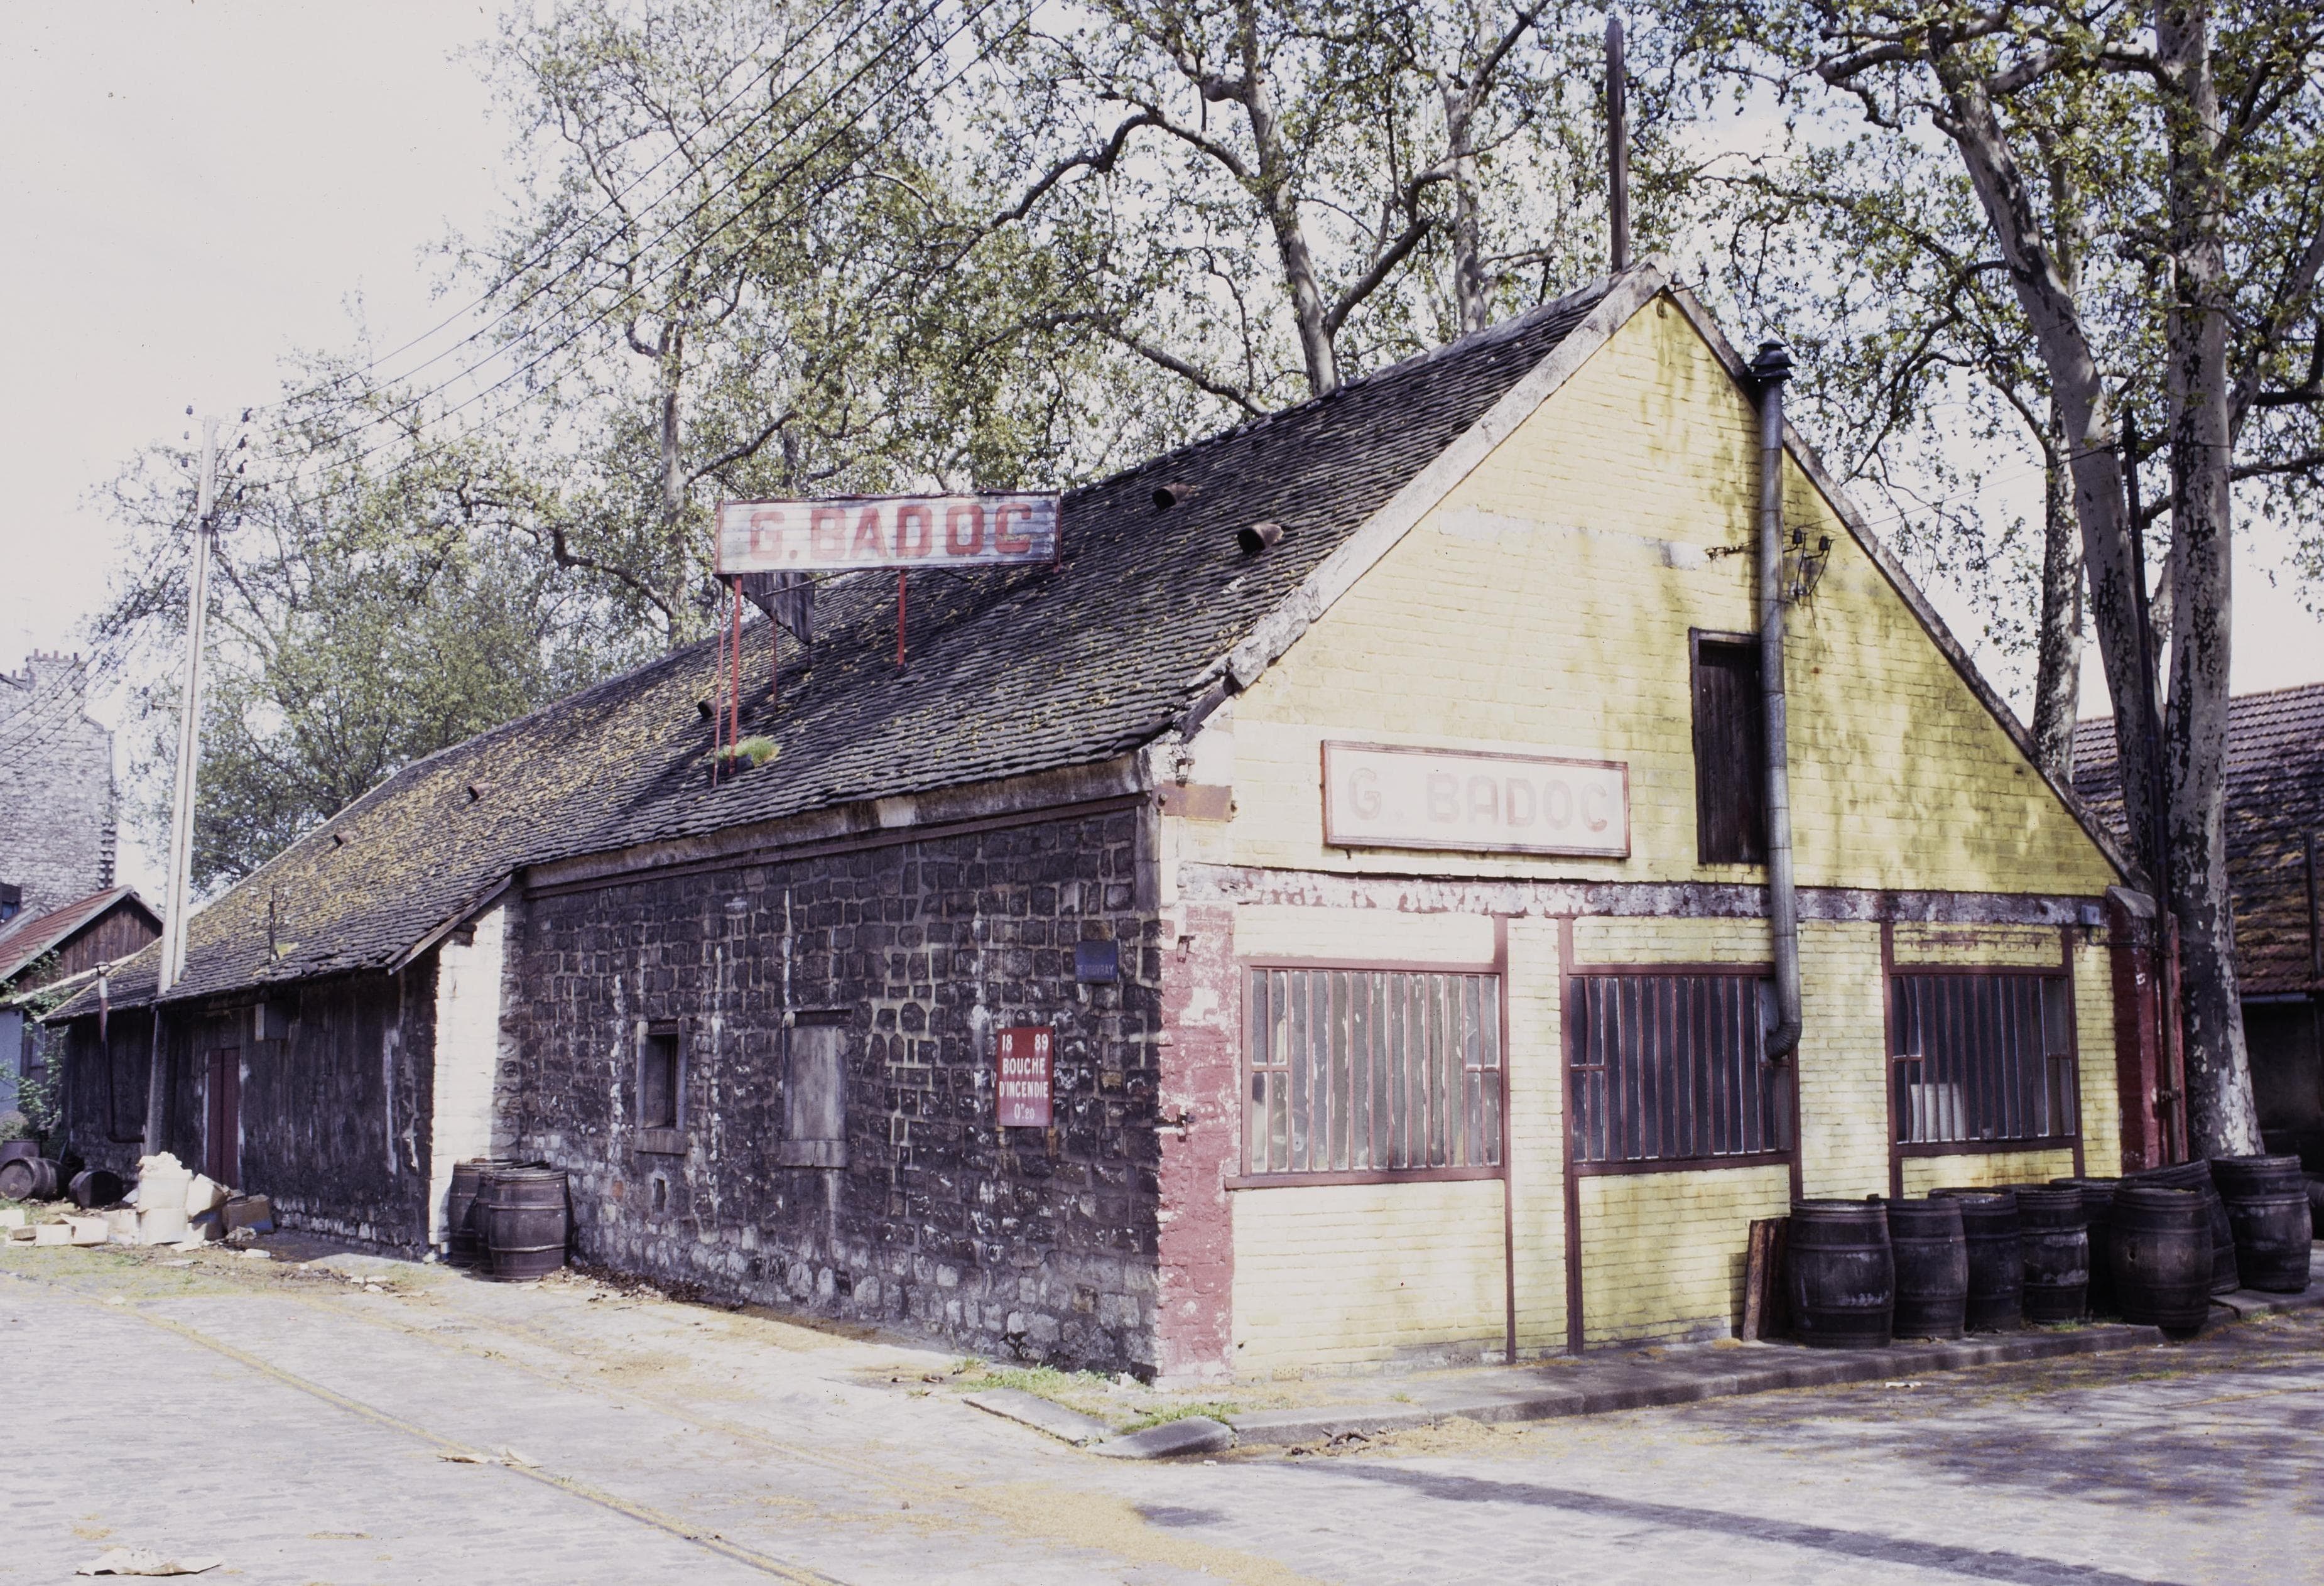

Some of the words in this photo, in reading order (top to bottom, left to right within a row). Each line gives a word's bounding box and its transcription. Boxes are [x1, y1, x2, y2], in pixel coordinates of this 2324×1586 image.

[1426, 773, 1608, 832] BADOC
[1002, 1035, 1013, 1051] 18
[1034, 1033, 1049, 1051] 89
[1002, 1057, 1046, 1075] BOUCHE
[999, 1081, 1049, 1098] D'INCENDIE
